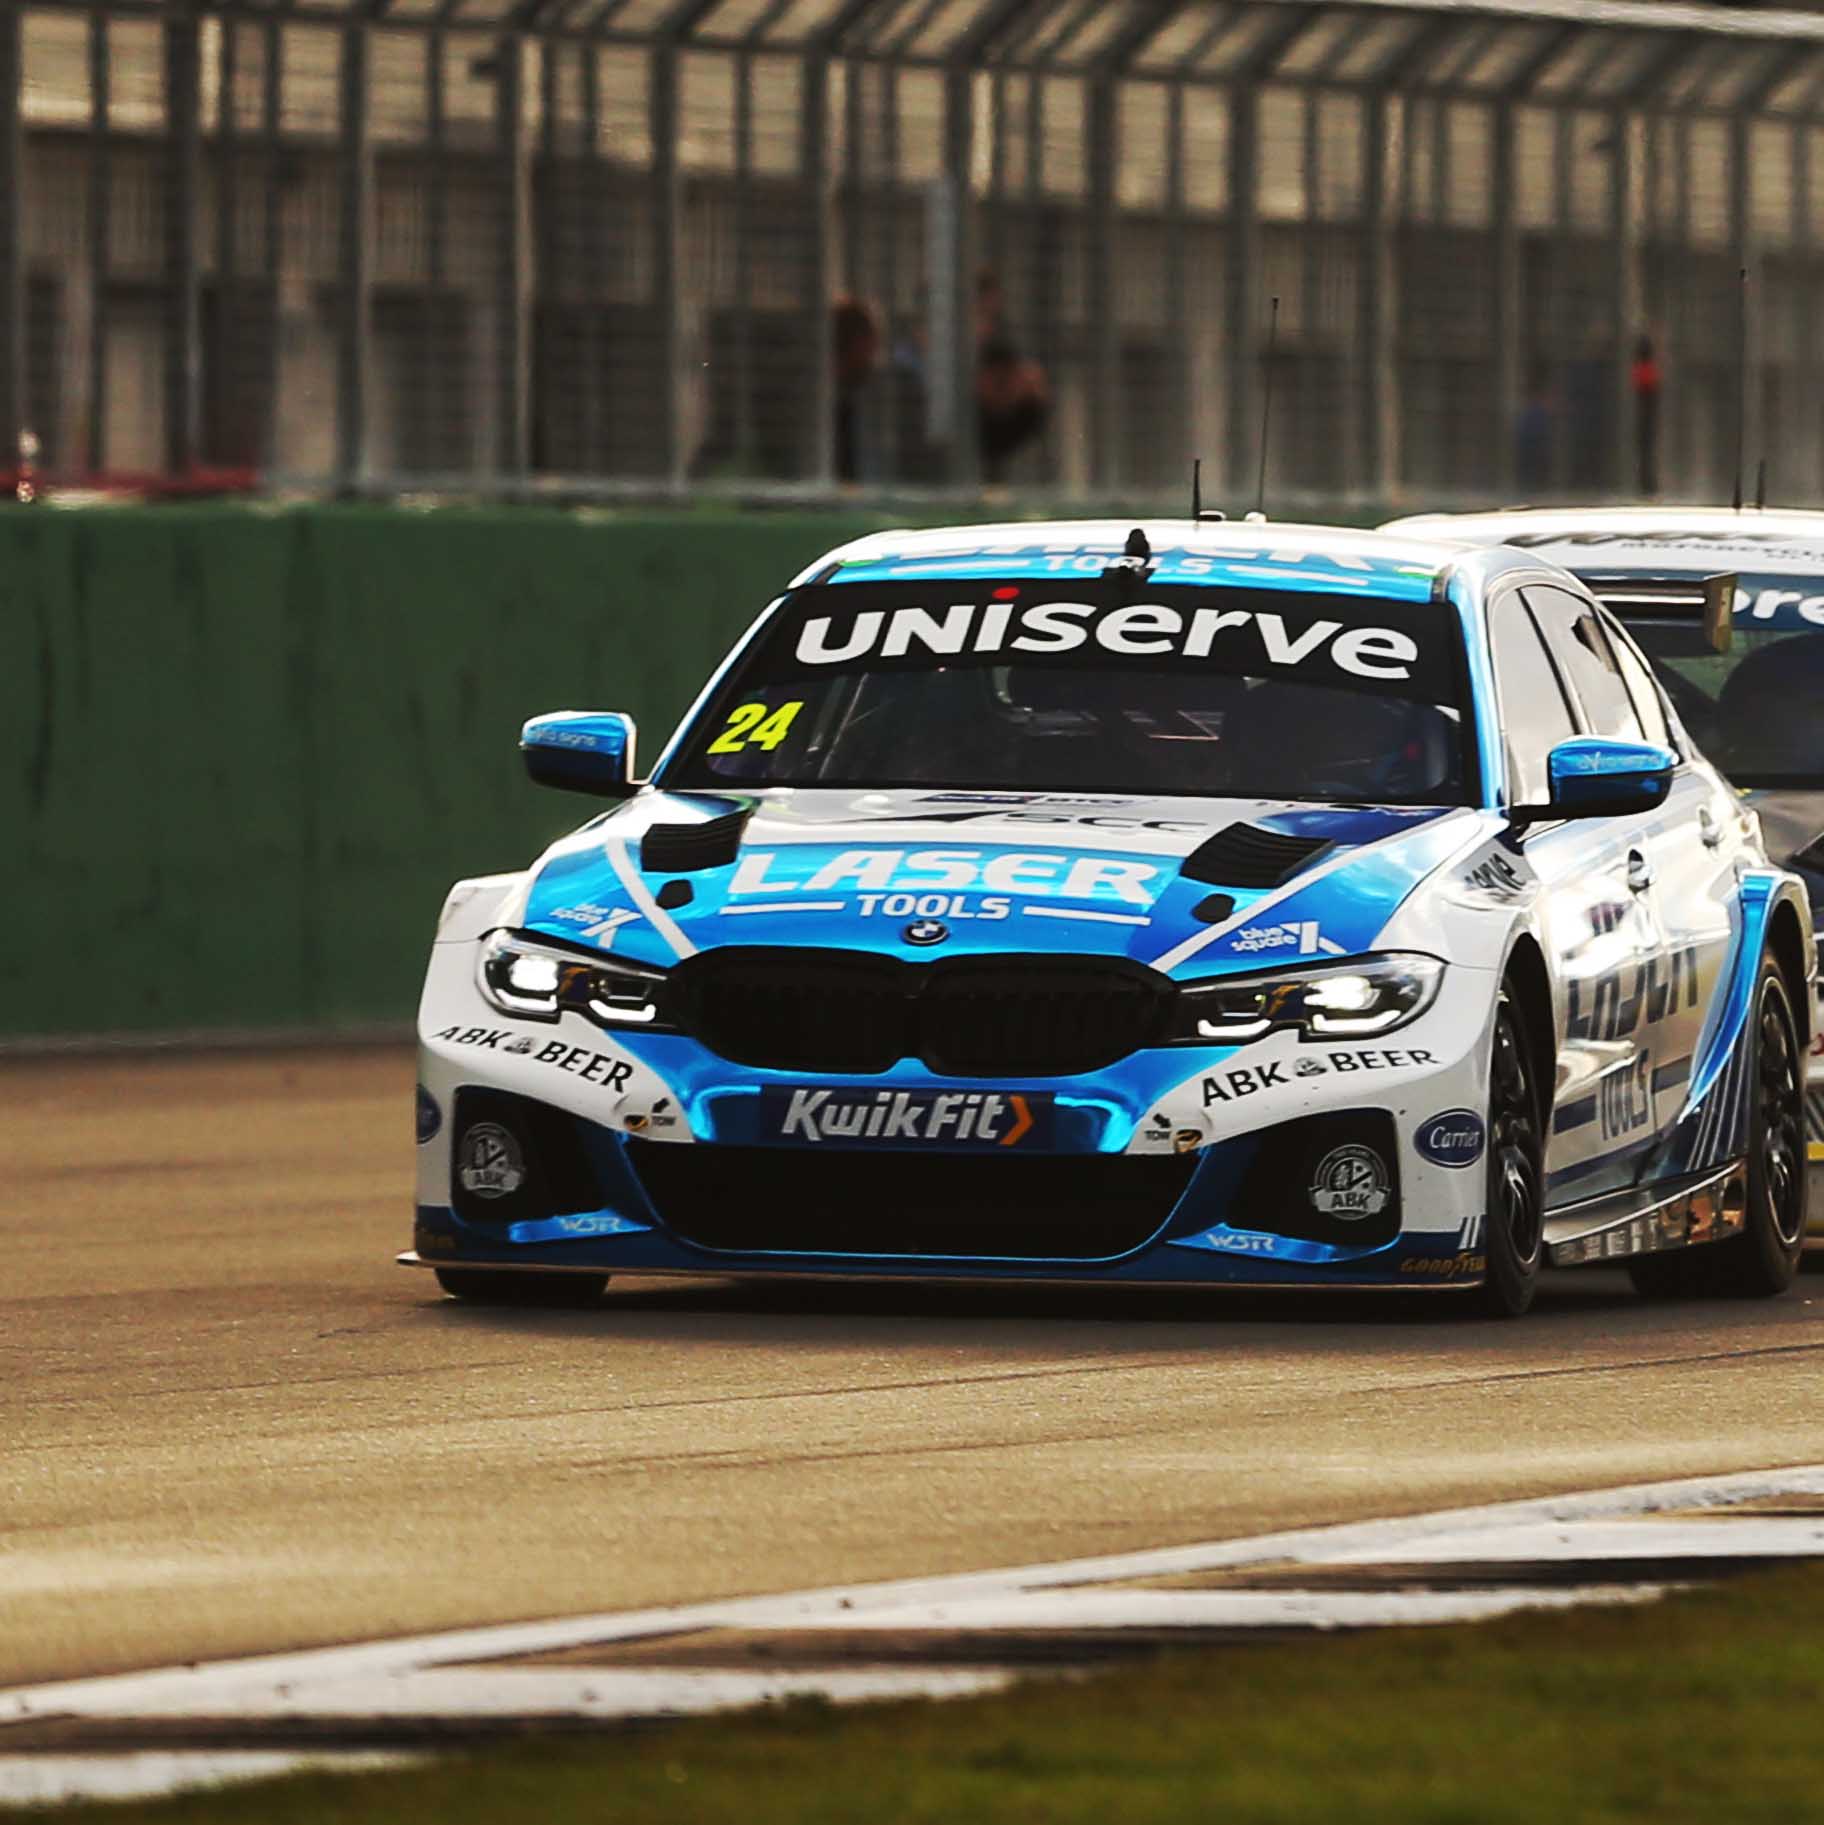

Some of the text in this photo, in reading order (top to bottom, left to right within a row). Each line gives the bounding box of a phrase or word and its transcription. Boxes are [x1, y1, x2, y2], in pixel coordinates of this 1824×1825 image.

[706, 702, 803, 754] 24
[727, 849, 1158, 904] LASER
[856, 893, 1011, 921] TOOLS
[433, 1024, 635, 1094] ABK BEER
[1201, 1048, 1444, 1109] ABK BEER
[1428, 1124, 1482, 1151] Carrier
[1330, 1193, 1370, 1210] ABK
